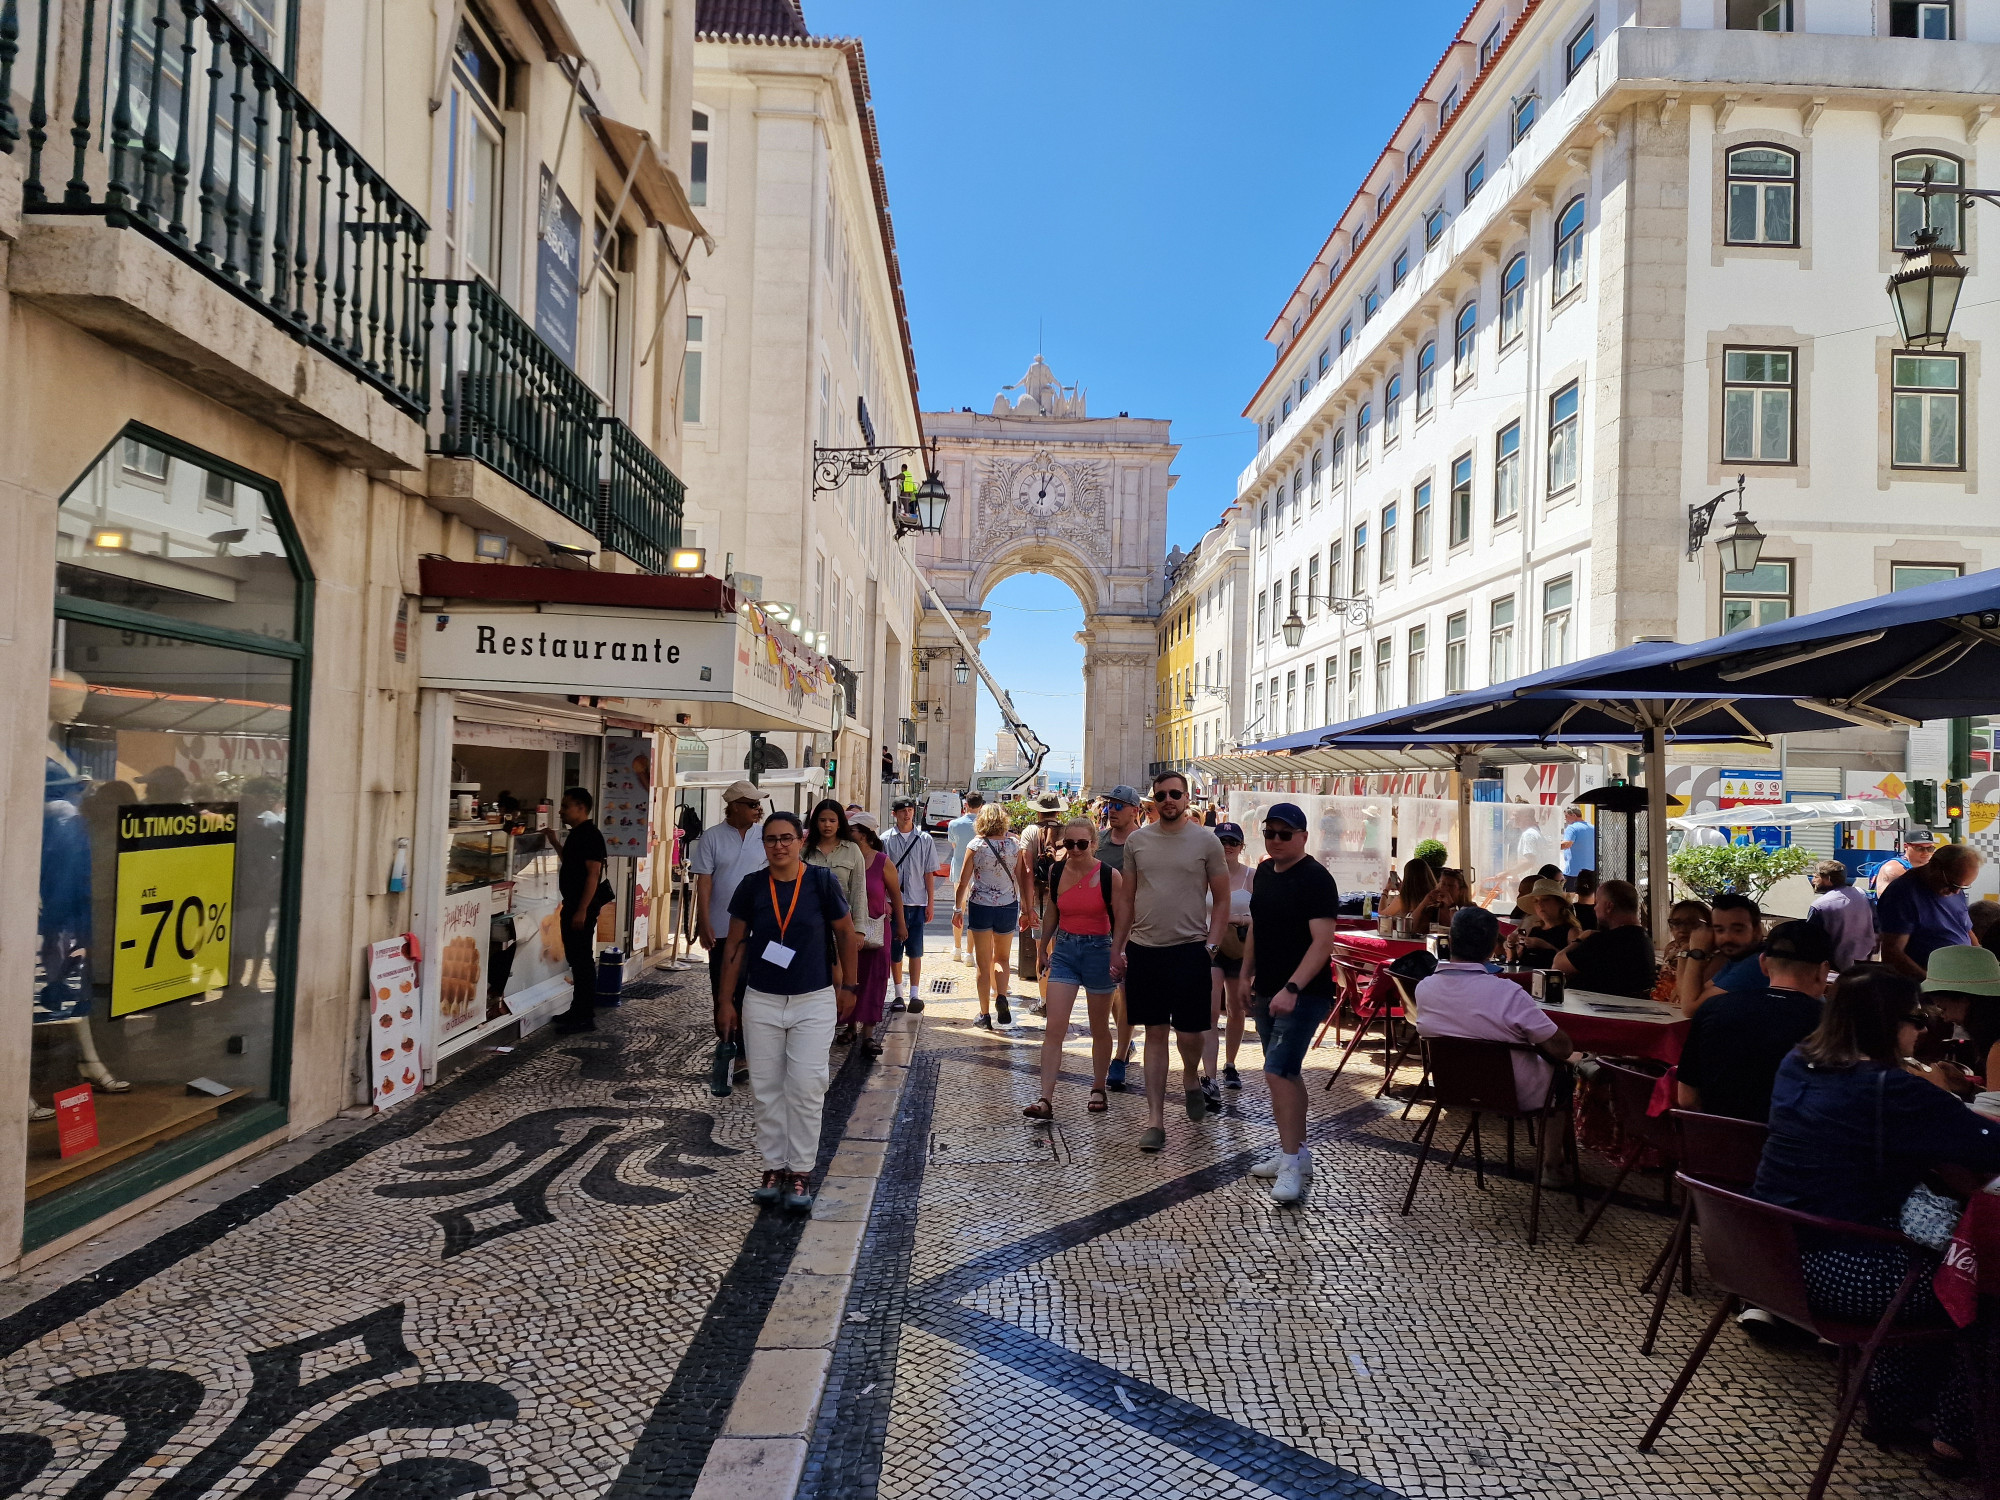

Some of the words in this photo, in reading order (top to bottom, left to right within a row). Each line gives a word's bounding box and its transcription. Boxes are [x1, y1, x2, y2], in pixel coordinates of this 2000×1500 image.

[476, 625, 680, 664] Restaurante
[121, 813, 196, 839] ÚLTIMOS
[199, 813, 236, 833] DIAS
[141, 887, 157, 898] ATÉ
[120, 896, 227, 970] -70%
